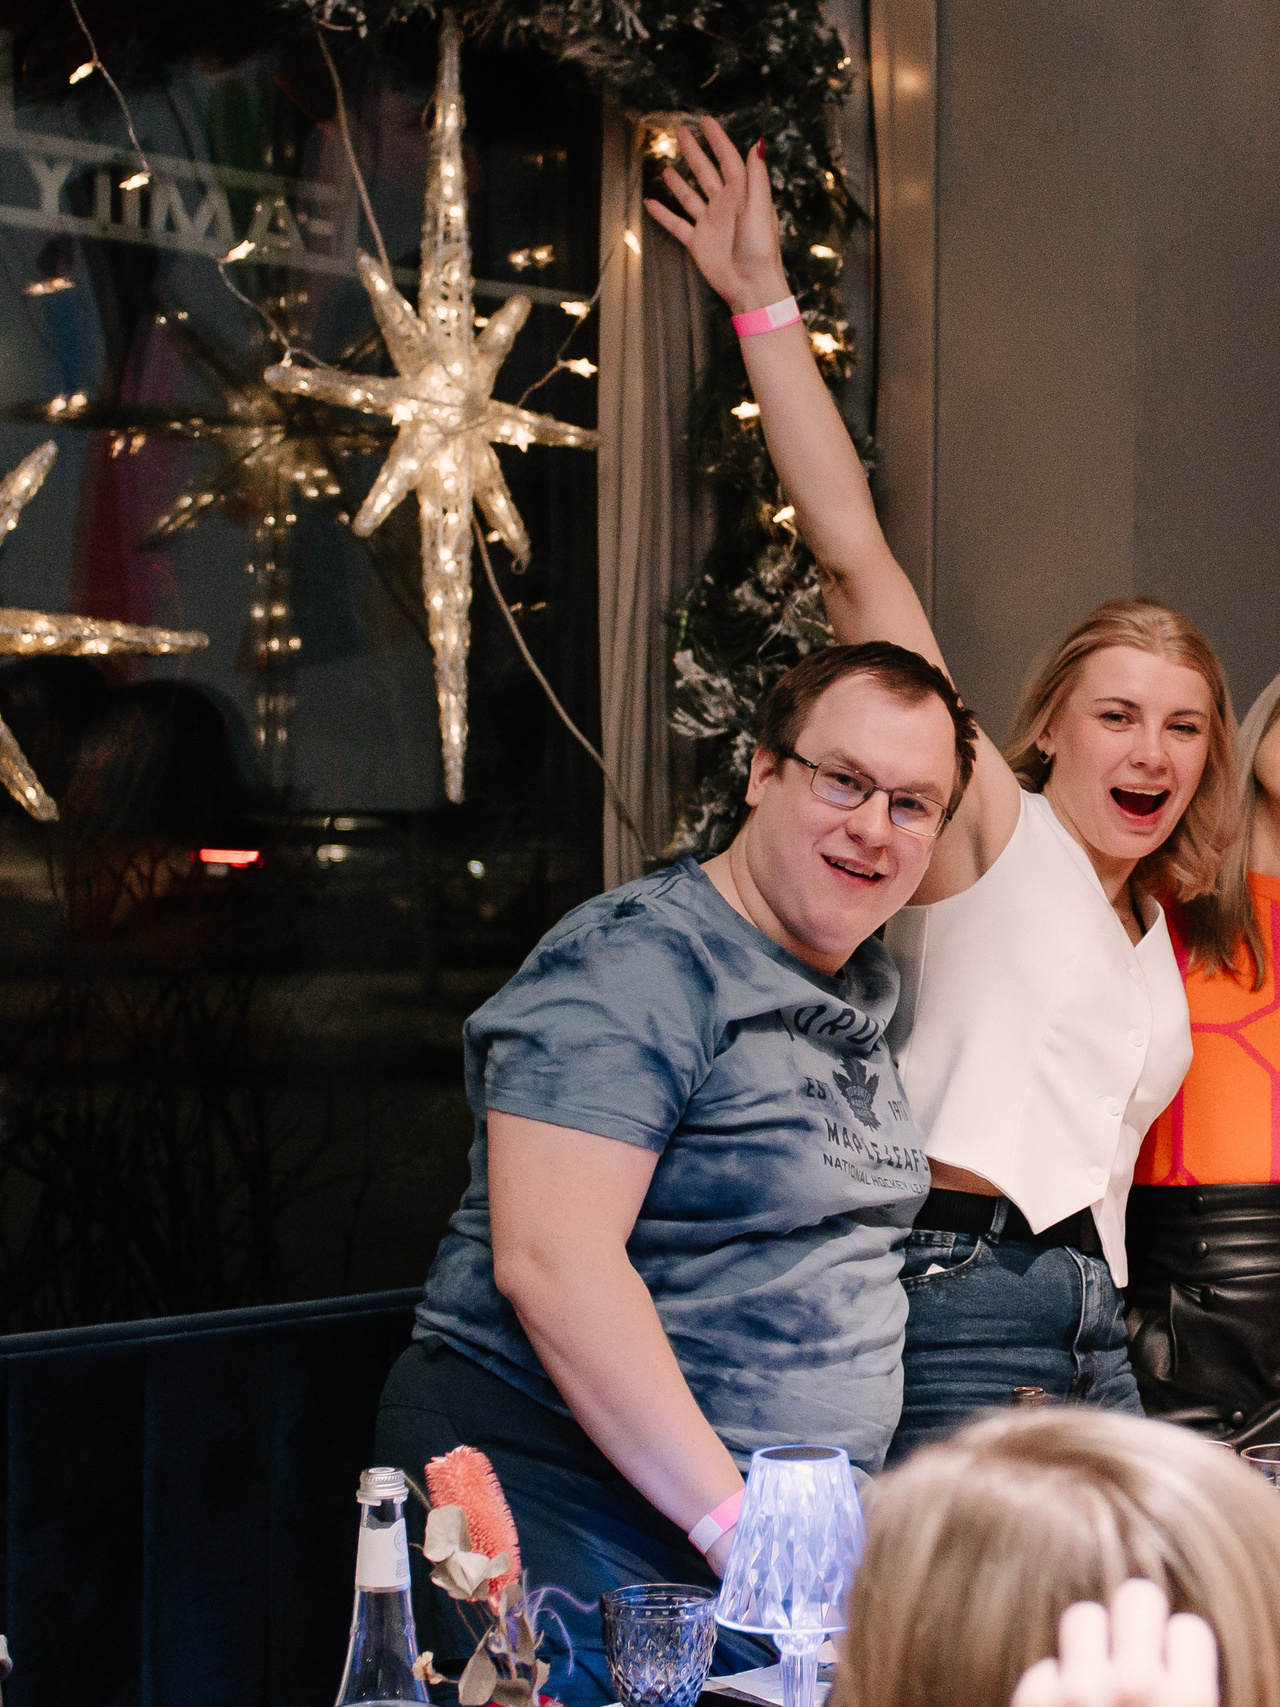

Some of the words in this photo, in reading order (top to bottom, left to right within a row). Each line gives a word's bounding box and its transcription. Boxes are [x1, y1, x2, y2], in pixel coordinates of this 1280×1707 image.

[824, 1117, 883, 1164] MAPLE
[822, 1153, 872, 1186] NATIONAL
[871, 1175, 909, 1190] HOCKEY
[908, 1182, 926, 1195] LEA
